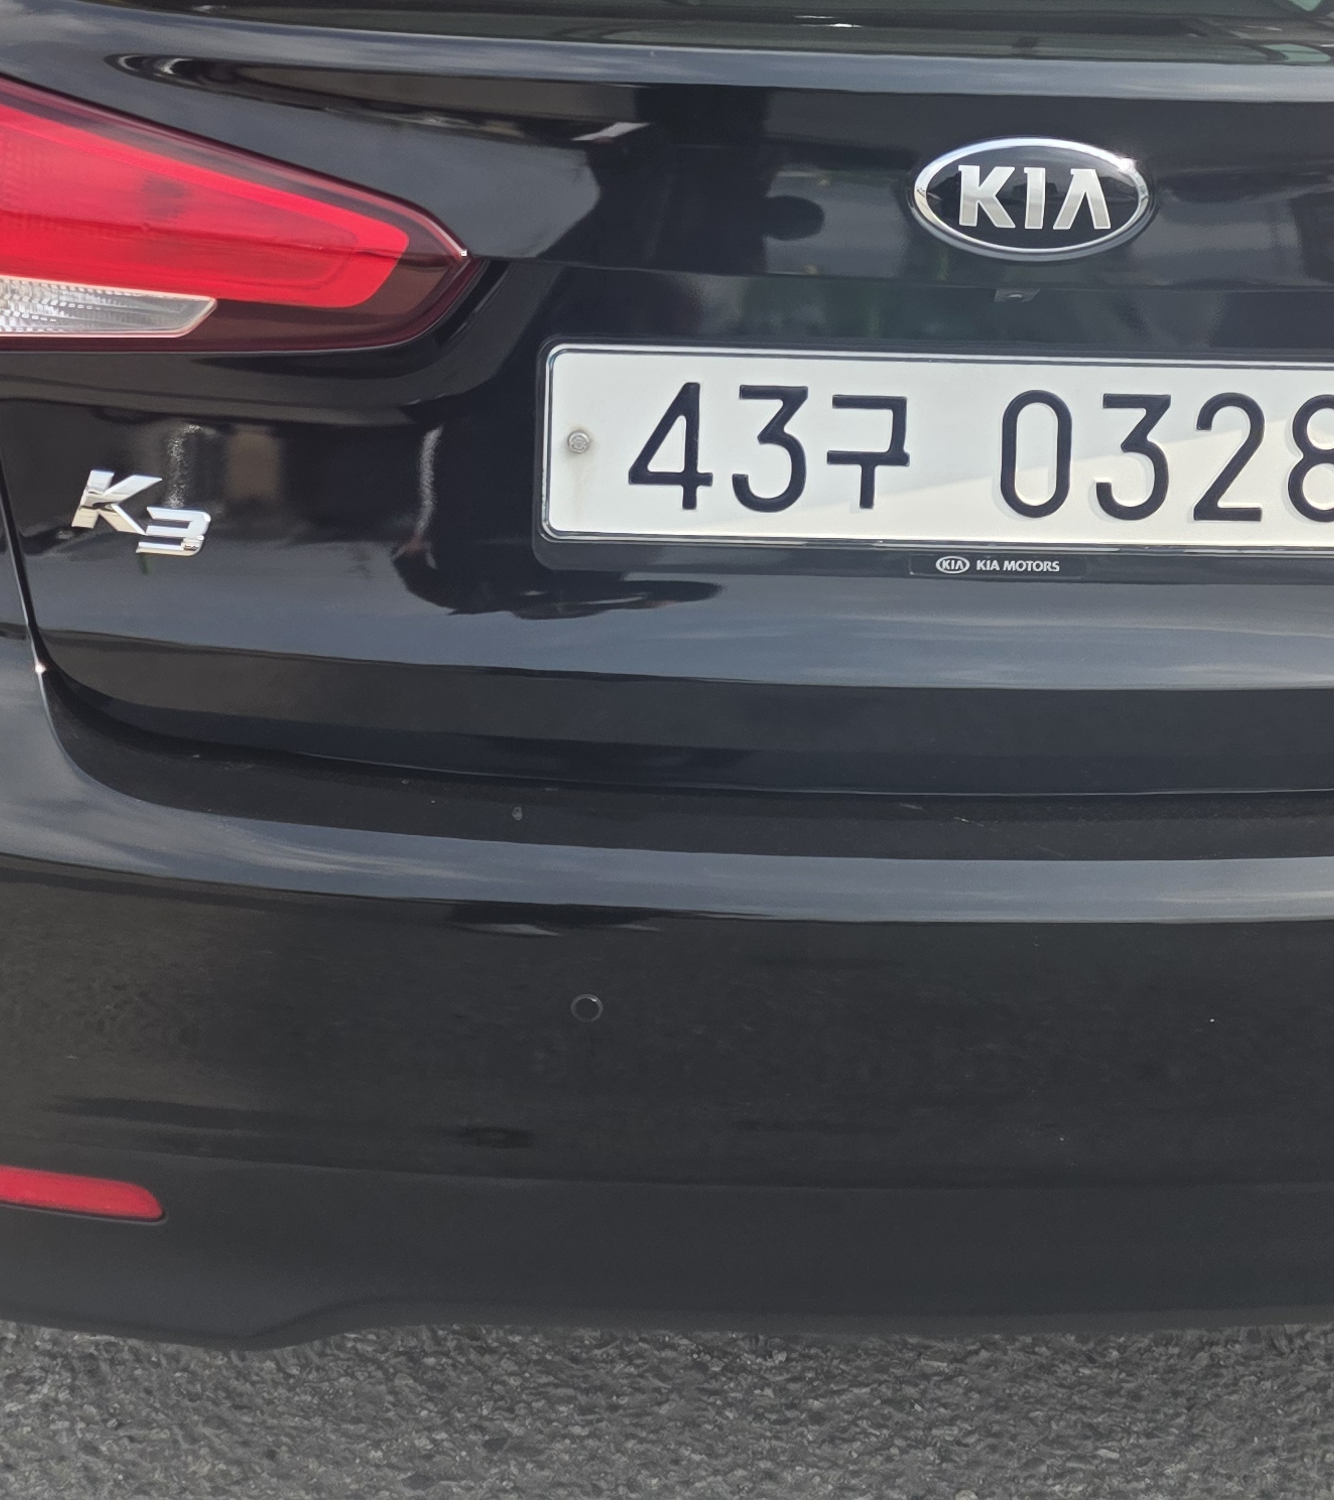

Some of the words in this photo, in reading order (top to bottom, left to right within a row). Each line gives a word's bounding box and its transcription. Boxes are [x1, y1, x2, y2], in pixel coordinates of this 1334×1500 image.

[957, 162, 1115, 232] KIA
[627, 381, 910, 514] 43구
[71, 469, 212, 557] K3
[976, 559, 1000, 571] KIA
[1003, 560, 1060, 572] MOTORS
